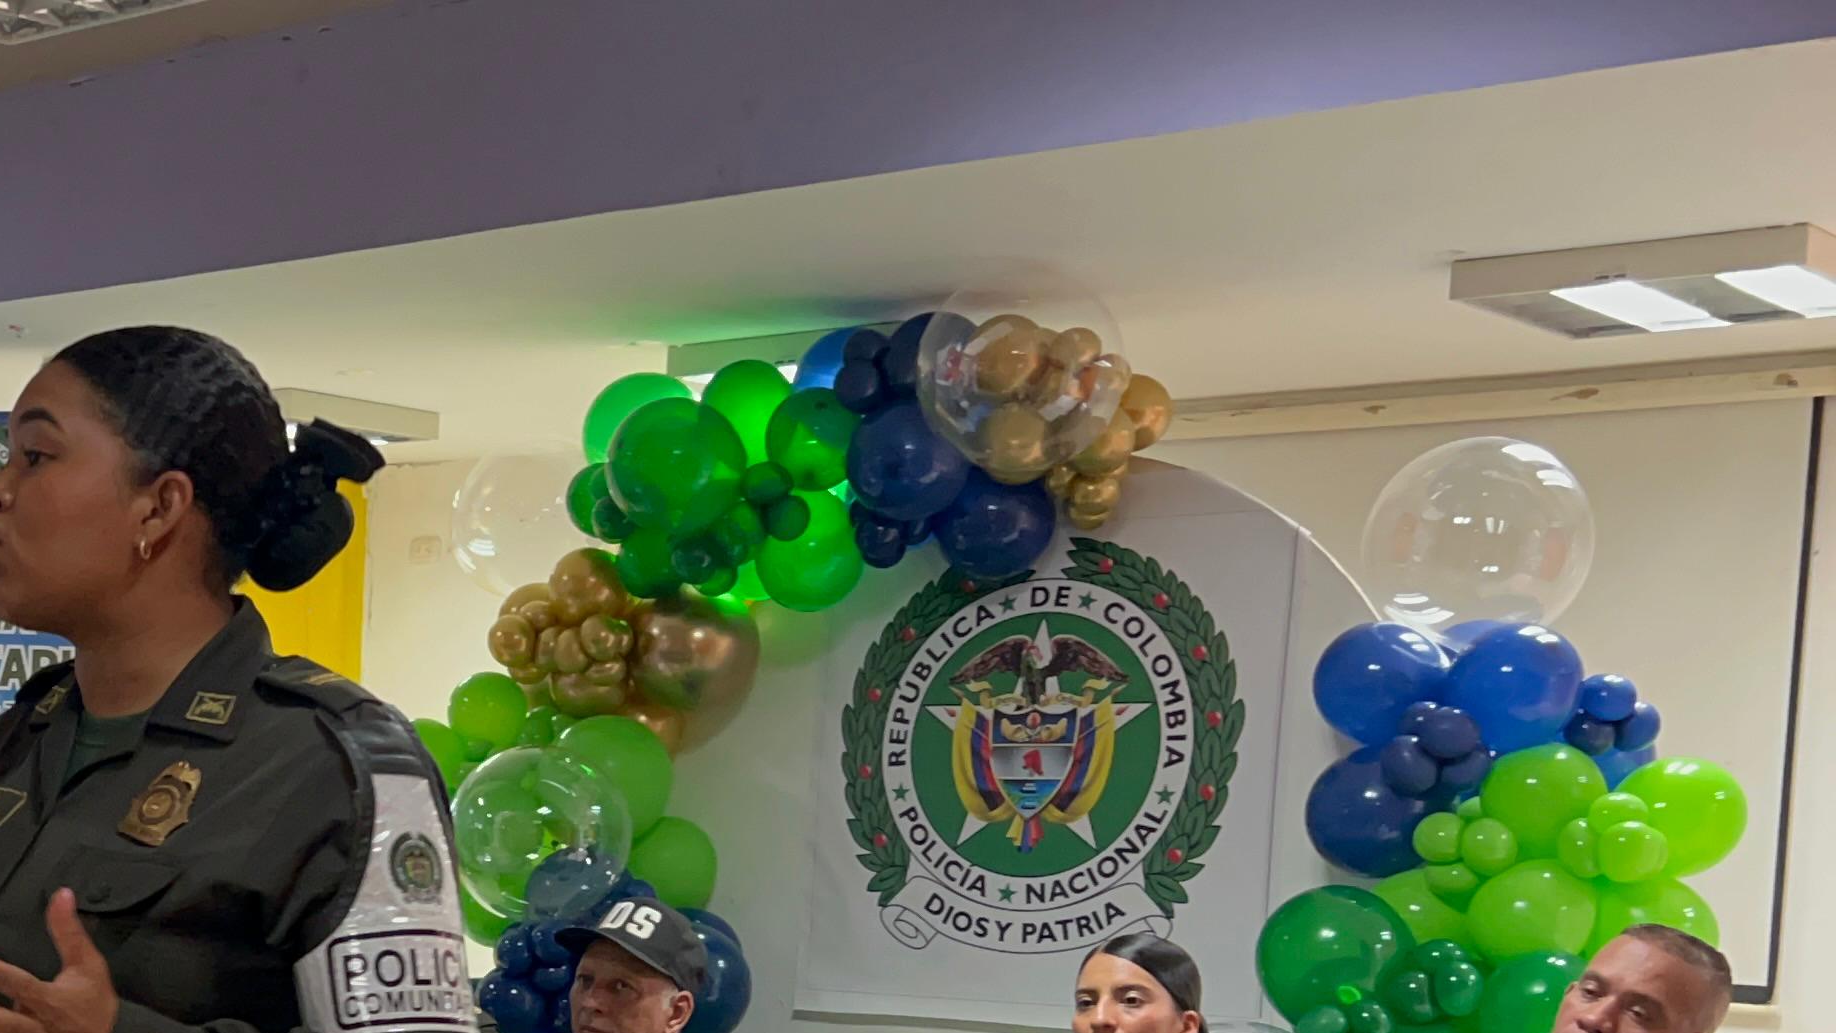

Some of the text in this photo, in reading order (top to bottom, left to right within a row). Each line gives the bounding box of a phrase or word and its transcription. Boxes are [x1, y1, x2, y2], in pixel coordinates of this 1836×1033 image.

[1029, 586, 1072, 608] DE
[1103, 602, 1187, 769] COLOMBIA
[1025, 809, 1169, 904] NACIONAL
[598, 901, 663, 939] DS
[923, 892, 1127, 944] DIOS Y PATRIA
[343, 948, 461, 992] POLIC
